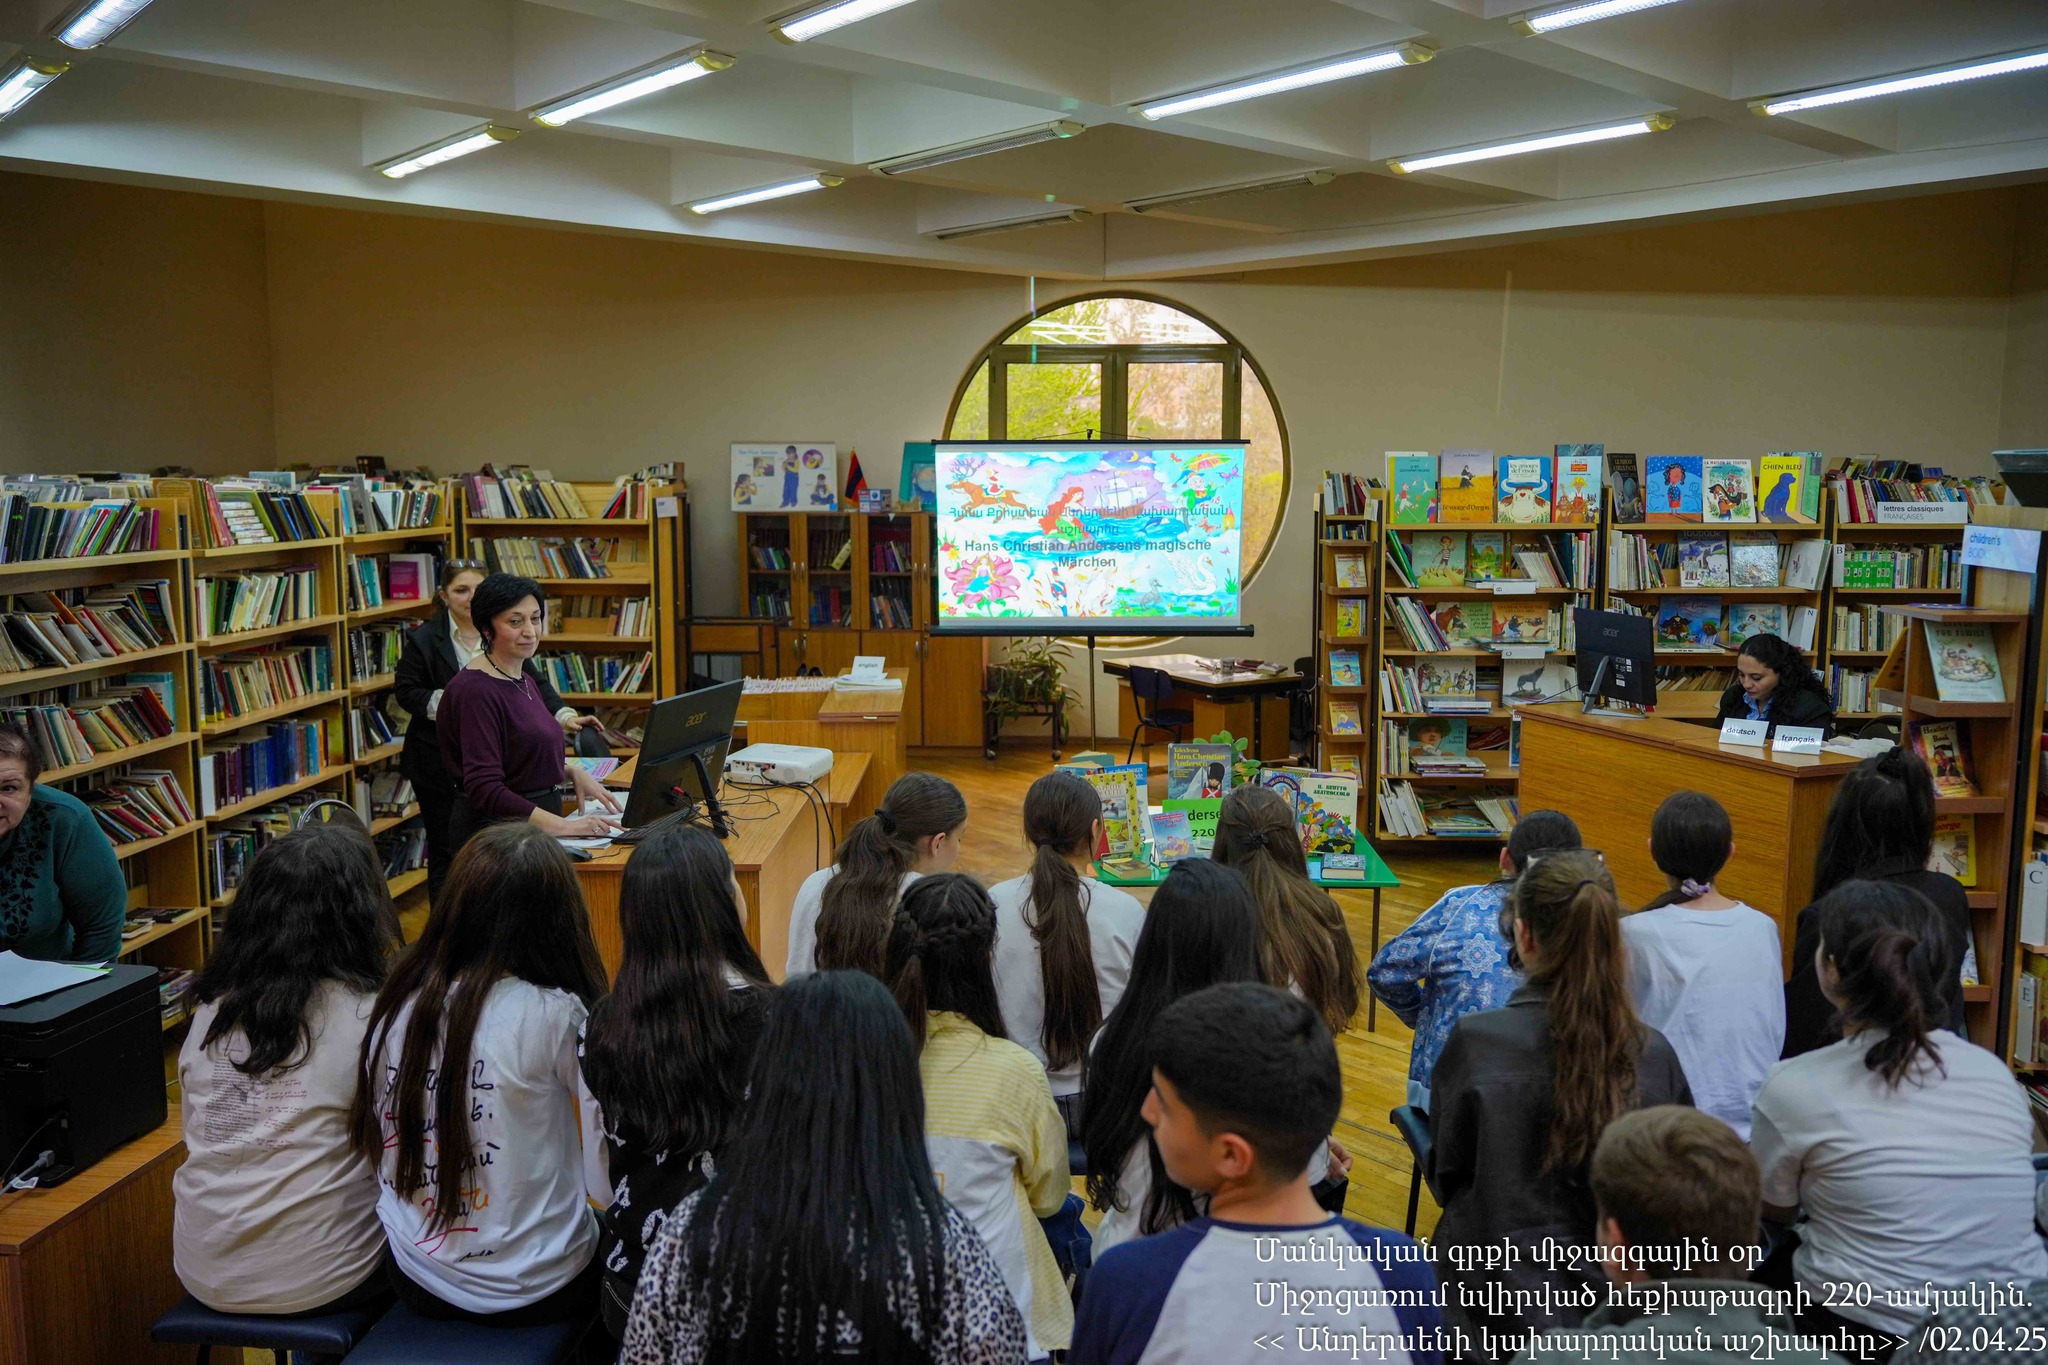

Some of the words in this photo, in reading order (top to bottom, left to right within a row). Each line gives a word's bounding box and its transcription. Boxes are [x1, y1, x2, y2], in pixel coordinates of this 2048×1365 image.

[1763, 463, 1783, 471] CHIEN
[1785, 463, 1802, 471] BLEU
[1838, 484, 1844, 492] A
[1906, 505, 1944, 514] classiques
[1884, 513, 1924, 522] FRANÇAISES
[1969, 533, 2001, 546] children's
[965, 540, 999, 552] Hans
[1003, 540, 1064, 552] Christian
[1067, 540, 1142, 552] Andersens
[1145, 539, 1212, 553] magische
[1836, 546, 1843, 555] B
[1058, 555, 1116, 568] Märchen
[1603, 628, 1619, 637] acer
[858, 662, 879, 670] english
[685, 711, 707, 728] acer
[1726, 727, 1757, 736] deutsch
[1923, 725, 1955, 735] Heather's
[1781, 734, 1816, 744] français
[1932, 733, 1949, 743] Book
[1936, 822, 1961, 831] eorge
[1191, 828, 1215, 837] 220
[2029, 870, 2043, 885] C
[2022, 987, 2031, 1002] E
